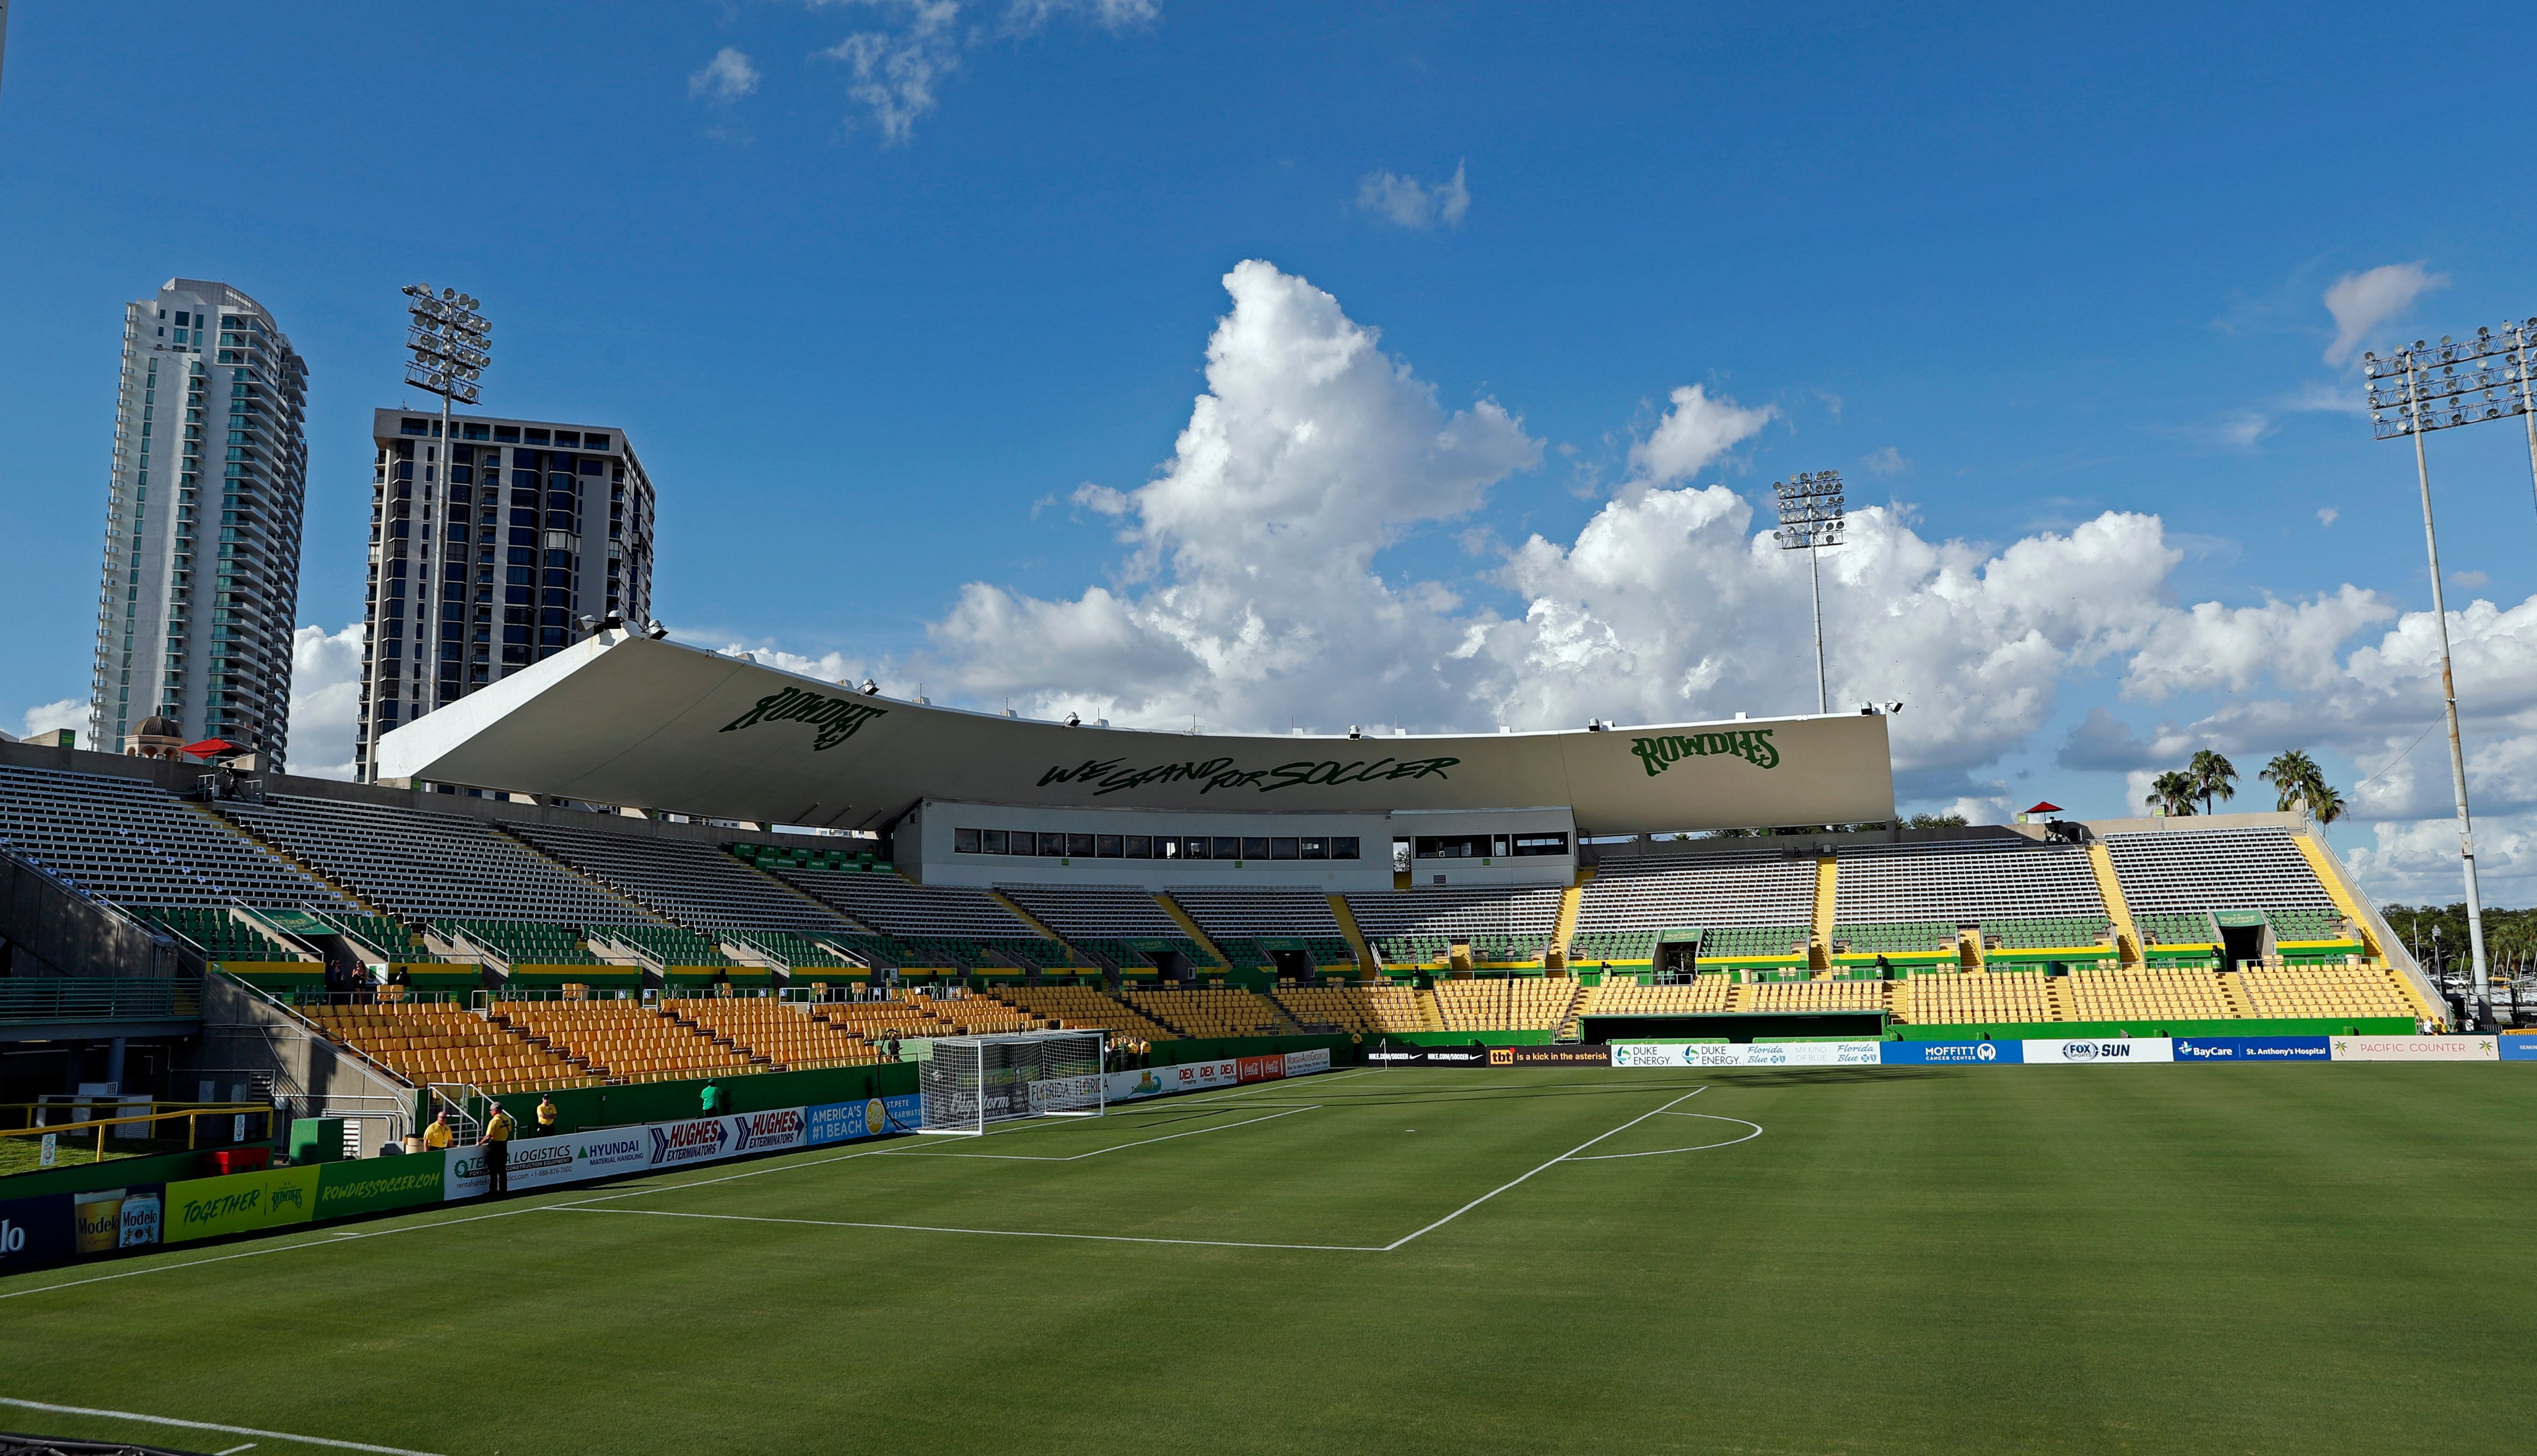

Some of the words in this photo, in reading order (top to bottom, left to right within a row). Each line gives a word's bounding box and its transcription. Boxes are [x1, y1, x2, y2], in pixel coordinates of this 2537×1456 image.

[718, 686, 888, 752] ROWDIES
[1631, 728, 1779, 777] ROWDIES
[1036, 757, 1127, 787] WE
[1093, 757, 1234, 796] STAND
[1200, 768, 1273, 795] FOR
[1259, 757, 1461, 793] SOCCER
[1633, 1047, 1657, 1055] DUKE
[1701, 1046, 1726, 1055] DUKE
[1747, 1045, 1784, 1053] Florida
[1837, 1044, 1874, 1052] Florida
[1925, 1046, 1975, 1056] MOFFITT
[2070, 1044, 2091, 1053] FOX
[2101, 1044, 2130, 1057] SUN
[2193, 1047, 2233, 1057] BayCare
[2258, 1048, 2294, 1056] Anthony's
[2294, 1047, 2326, 1055] Hospital
[2360, 1043, 2404, 1052] PACIFIC
[2409, 1043, 2466, 1053] COUNTER
[1428, 1053, 1469, 1061] NIKE.COM/SOCCER
[1532, 1052, 1548, 1060] kick
[1560, 1052, 1573, 1060] the
[1575, 1052, 1608, 1060] asterisk
[1633, 1057, 1670, 1065] ENERGY
[1701, 1056, 1739, 1065] ENERGY
[1747, 1055, 1768, 1063] Blue
[1837, 1054, 1859, 1062] Blue
[1179, 1068, 1194, 1080] DEX
[1200, 1065, 1215, 1077] DEX
[1220, 1064, 1235, 1075] DEX
[886, 1099, 909, 1109] ST.PETE
[812, 1105, 862, 1124] AMERICA'S
[751, 1110, 797, 1136] HUGHES
[668, 1120, 719, 1149] HUGHES
[813, 1125, 823, 1140] #1
[827, 1120, 862, 1138] BEACH
[748, 1133, 794, 1149] EXTERMINATORS
[513, 1145, 570, 1163] LOGISTICS
[590, 1140, 639, 1157] HYUNDAI
[666, 1144, 717, 1162] EXTERMINATORS
[505, 1161, 543, 1171] CONSTRUCTION
[544, 1157, 570, 1166] EQUIPMENT
[590, 1157, 616, 1166] MATERIAL
[617, 1153, 644, 1162] HANDLING
[535, 1166, 572, 1176] 1-888-876-7602
[322, 1172, 440, 1201] ROWDIESSOCCER.COM
[271, 1188, 303, 1212] ROWDIES
[183, 1189, 260, 1227] TOGETHER
[79, 1215, 120, 1234] Modelo
[123, 1210, 157, 1227] Modelo
